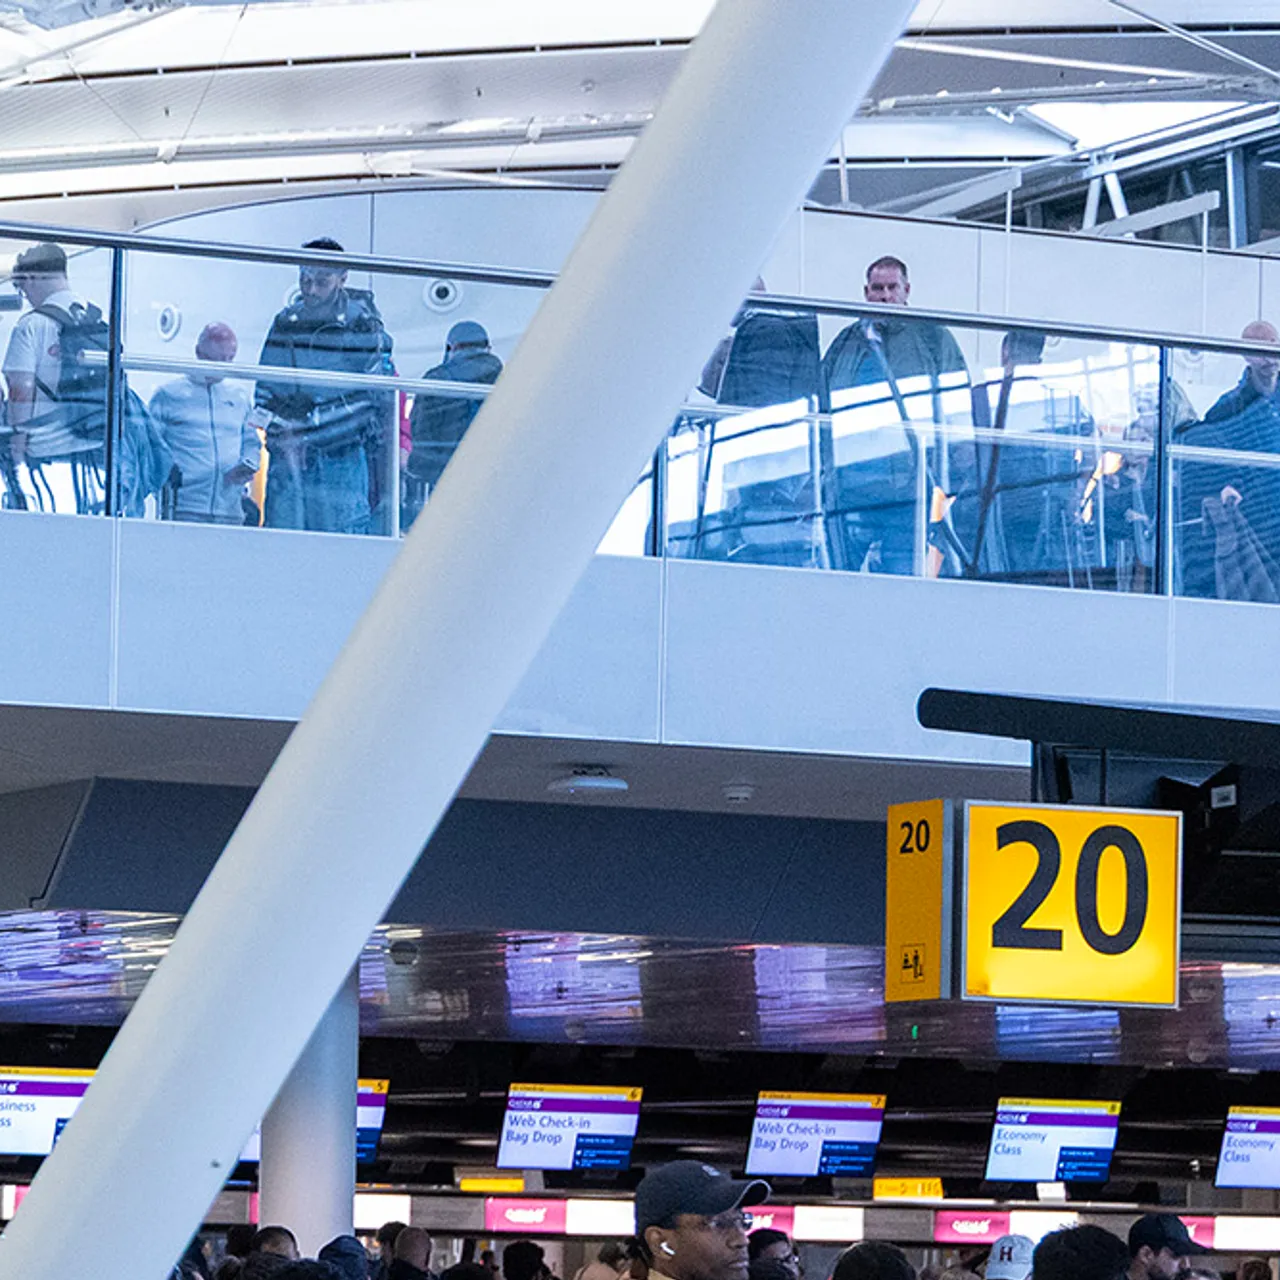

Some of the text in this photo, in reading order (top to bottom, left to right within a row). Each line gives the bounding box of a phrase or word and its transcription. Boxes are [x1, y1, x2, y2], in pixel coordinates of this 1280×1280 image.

[899, 819, 931, 854] 20
[991, 819, 1149, 956] 20
[508, 1115, 592, 1129] Web Check-in
[757, 1122, 836, 1136] Web Check-in
[505, 1131, 529, 1145] Bag
[532, 1131, 563, 1145] Drop
[996, 1128, 1048, 1144] Economy
[1226, 1135, 1276, 1151] Economy
[754, 1137, 777, 1151] Bag
[780, 1138, 809, 1152] Drop
[993, 1144, 1022, 1155] Class
[1223, 1151, 1251, 1163] Class
[999, 1246, 1013, 1262] H
